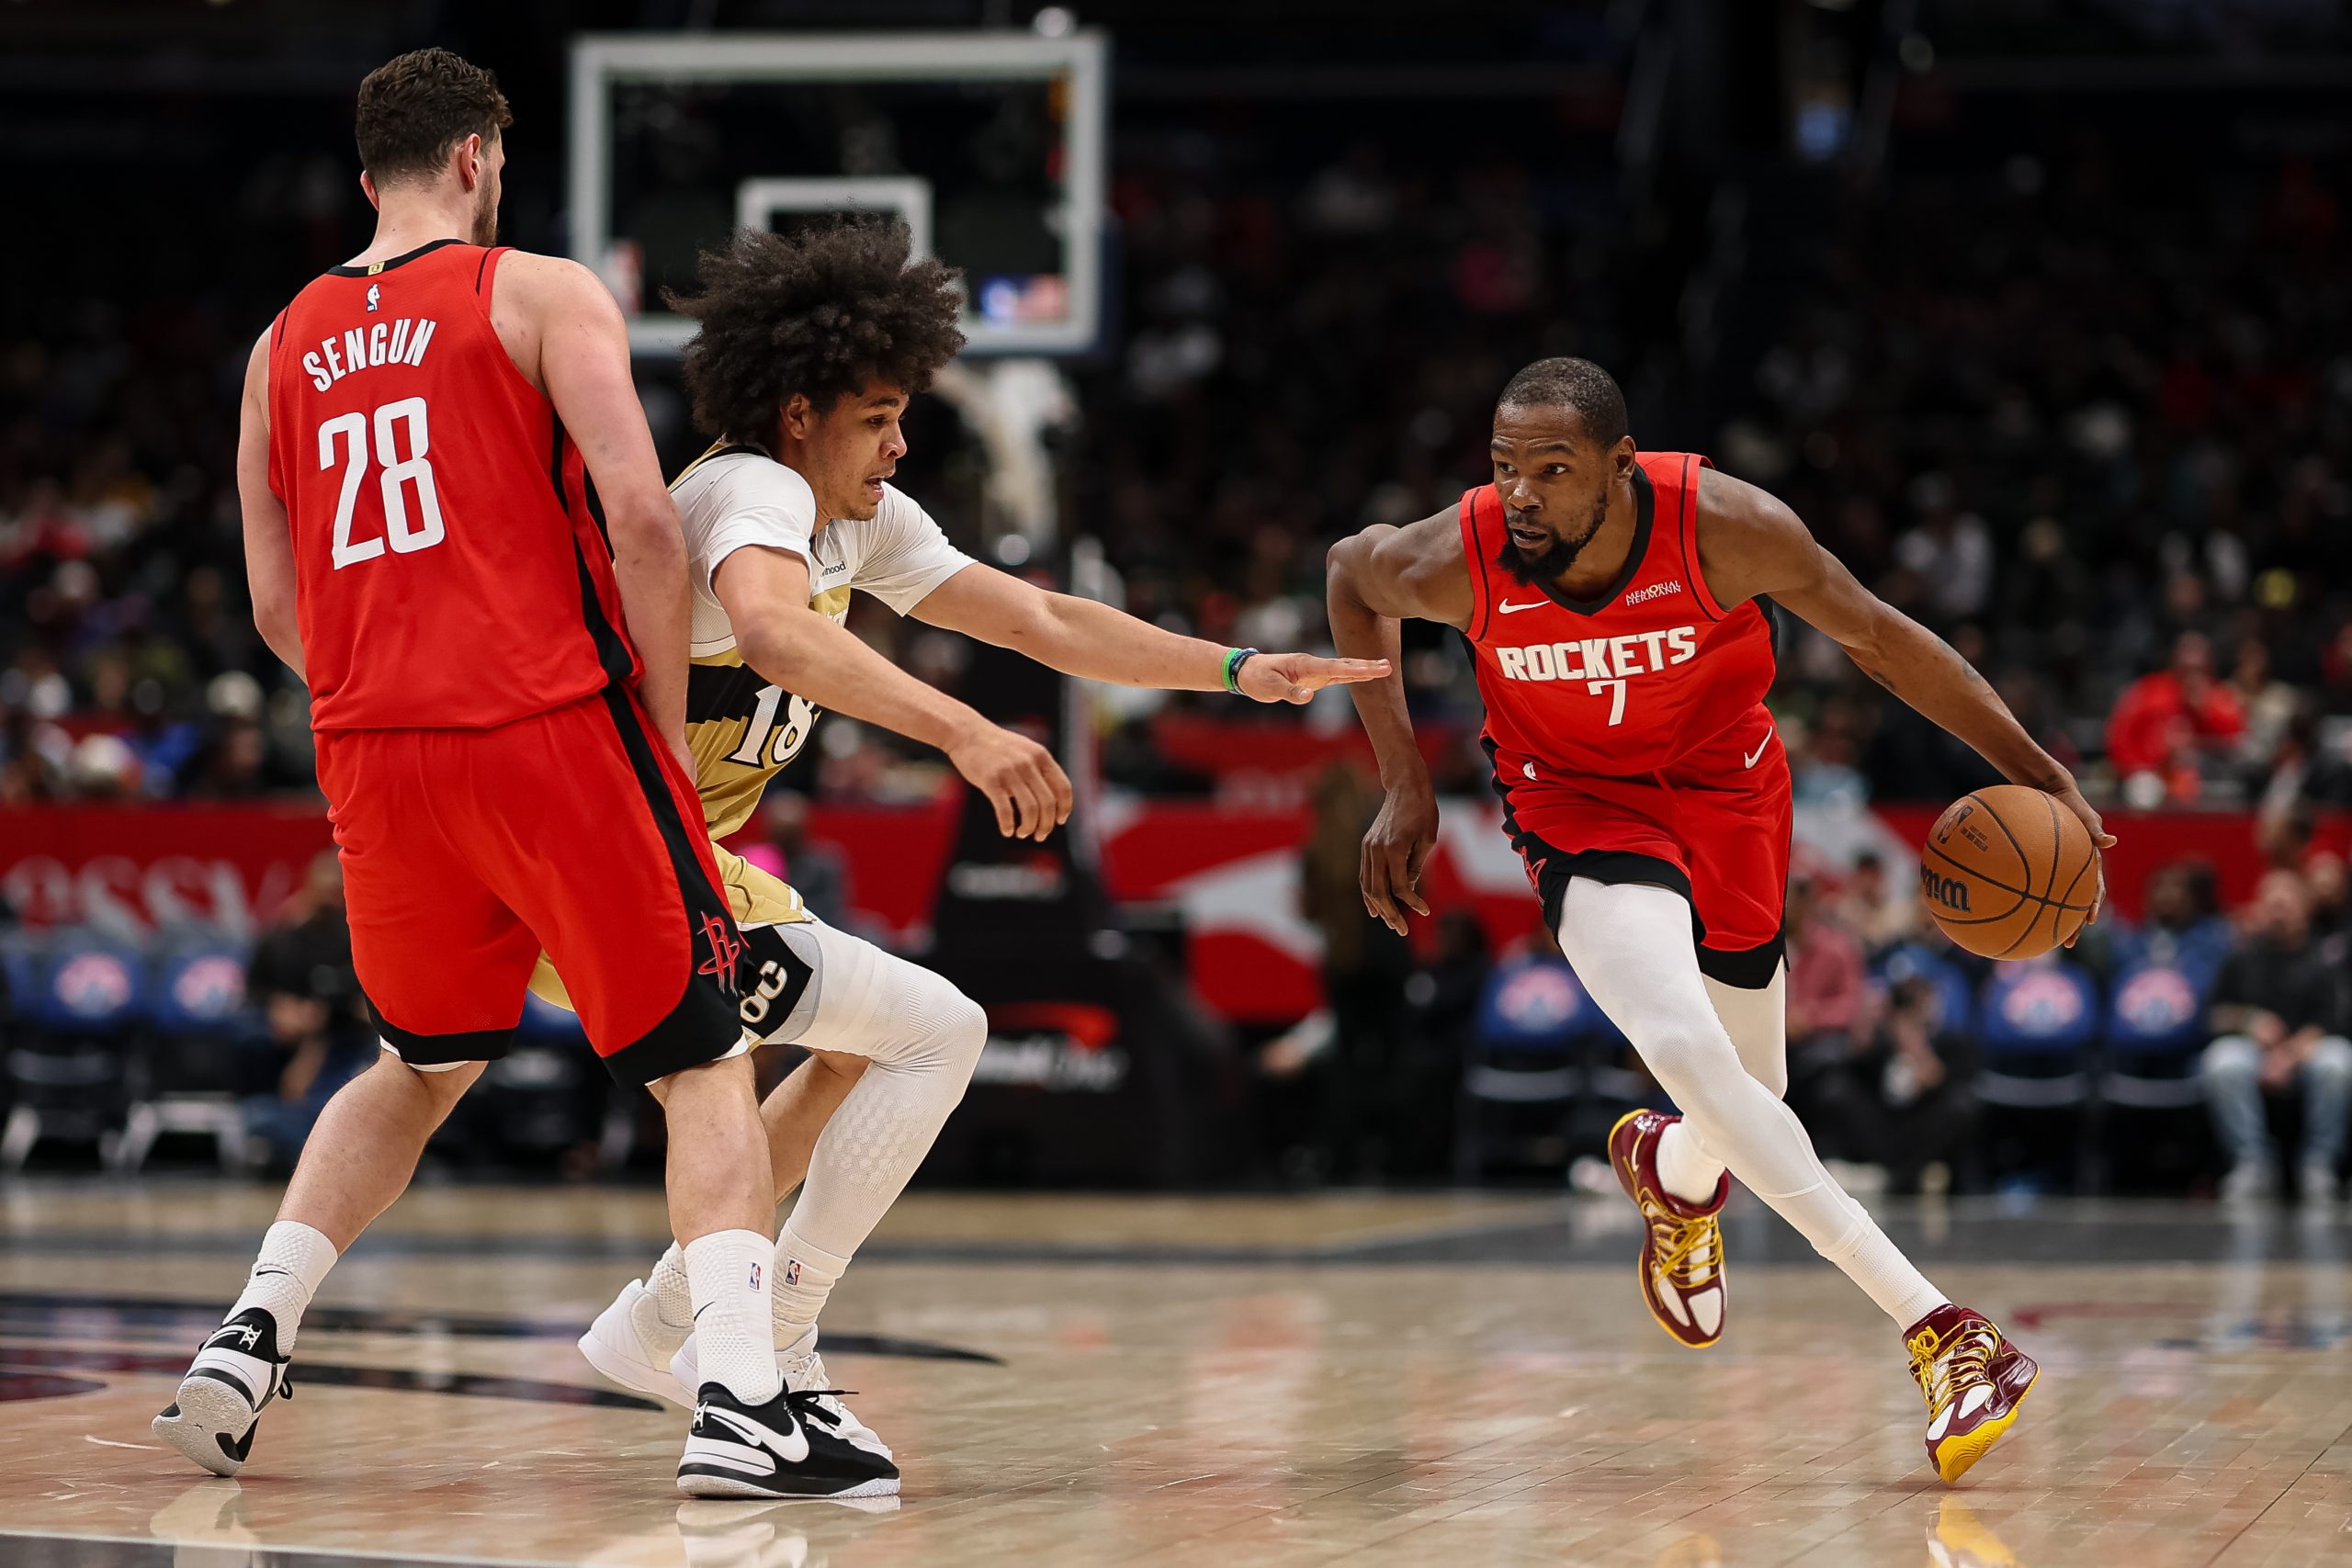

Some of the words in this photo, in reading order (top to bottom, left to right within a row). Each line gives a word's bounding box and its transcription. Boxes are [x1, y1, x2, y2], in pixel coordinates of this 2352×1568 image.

[302, 318, 437, 393] SENGUN
[318, 396, 446, 570] 28
[1625, 580, 1680, 601] MEMORIAL
[1626, 584, 1681, 606] HERMANN
[1495, 626, 1697, 682] ROCKETS
[721, 683, 814, 769] 18
[1587, 679, 1626, 726] 7
